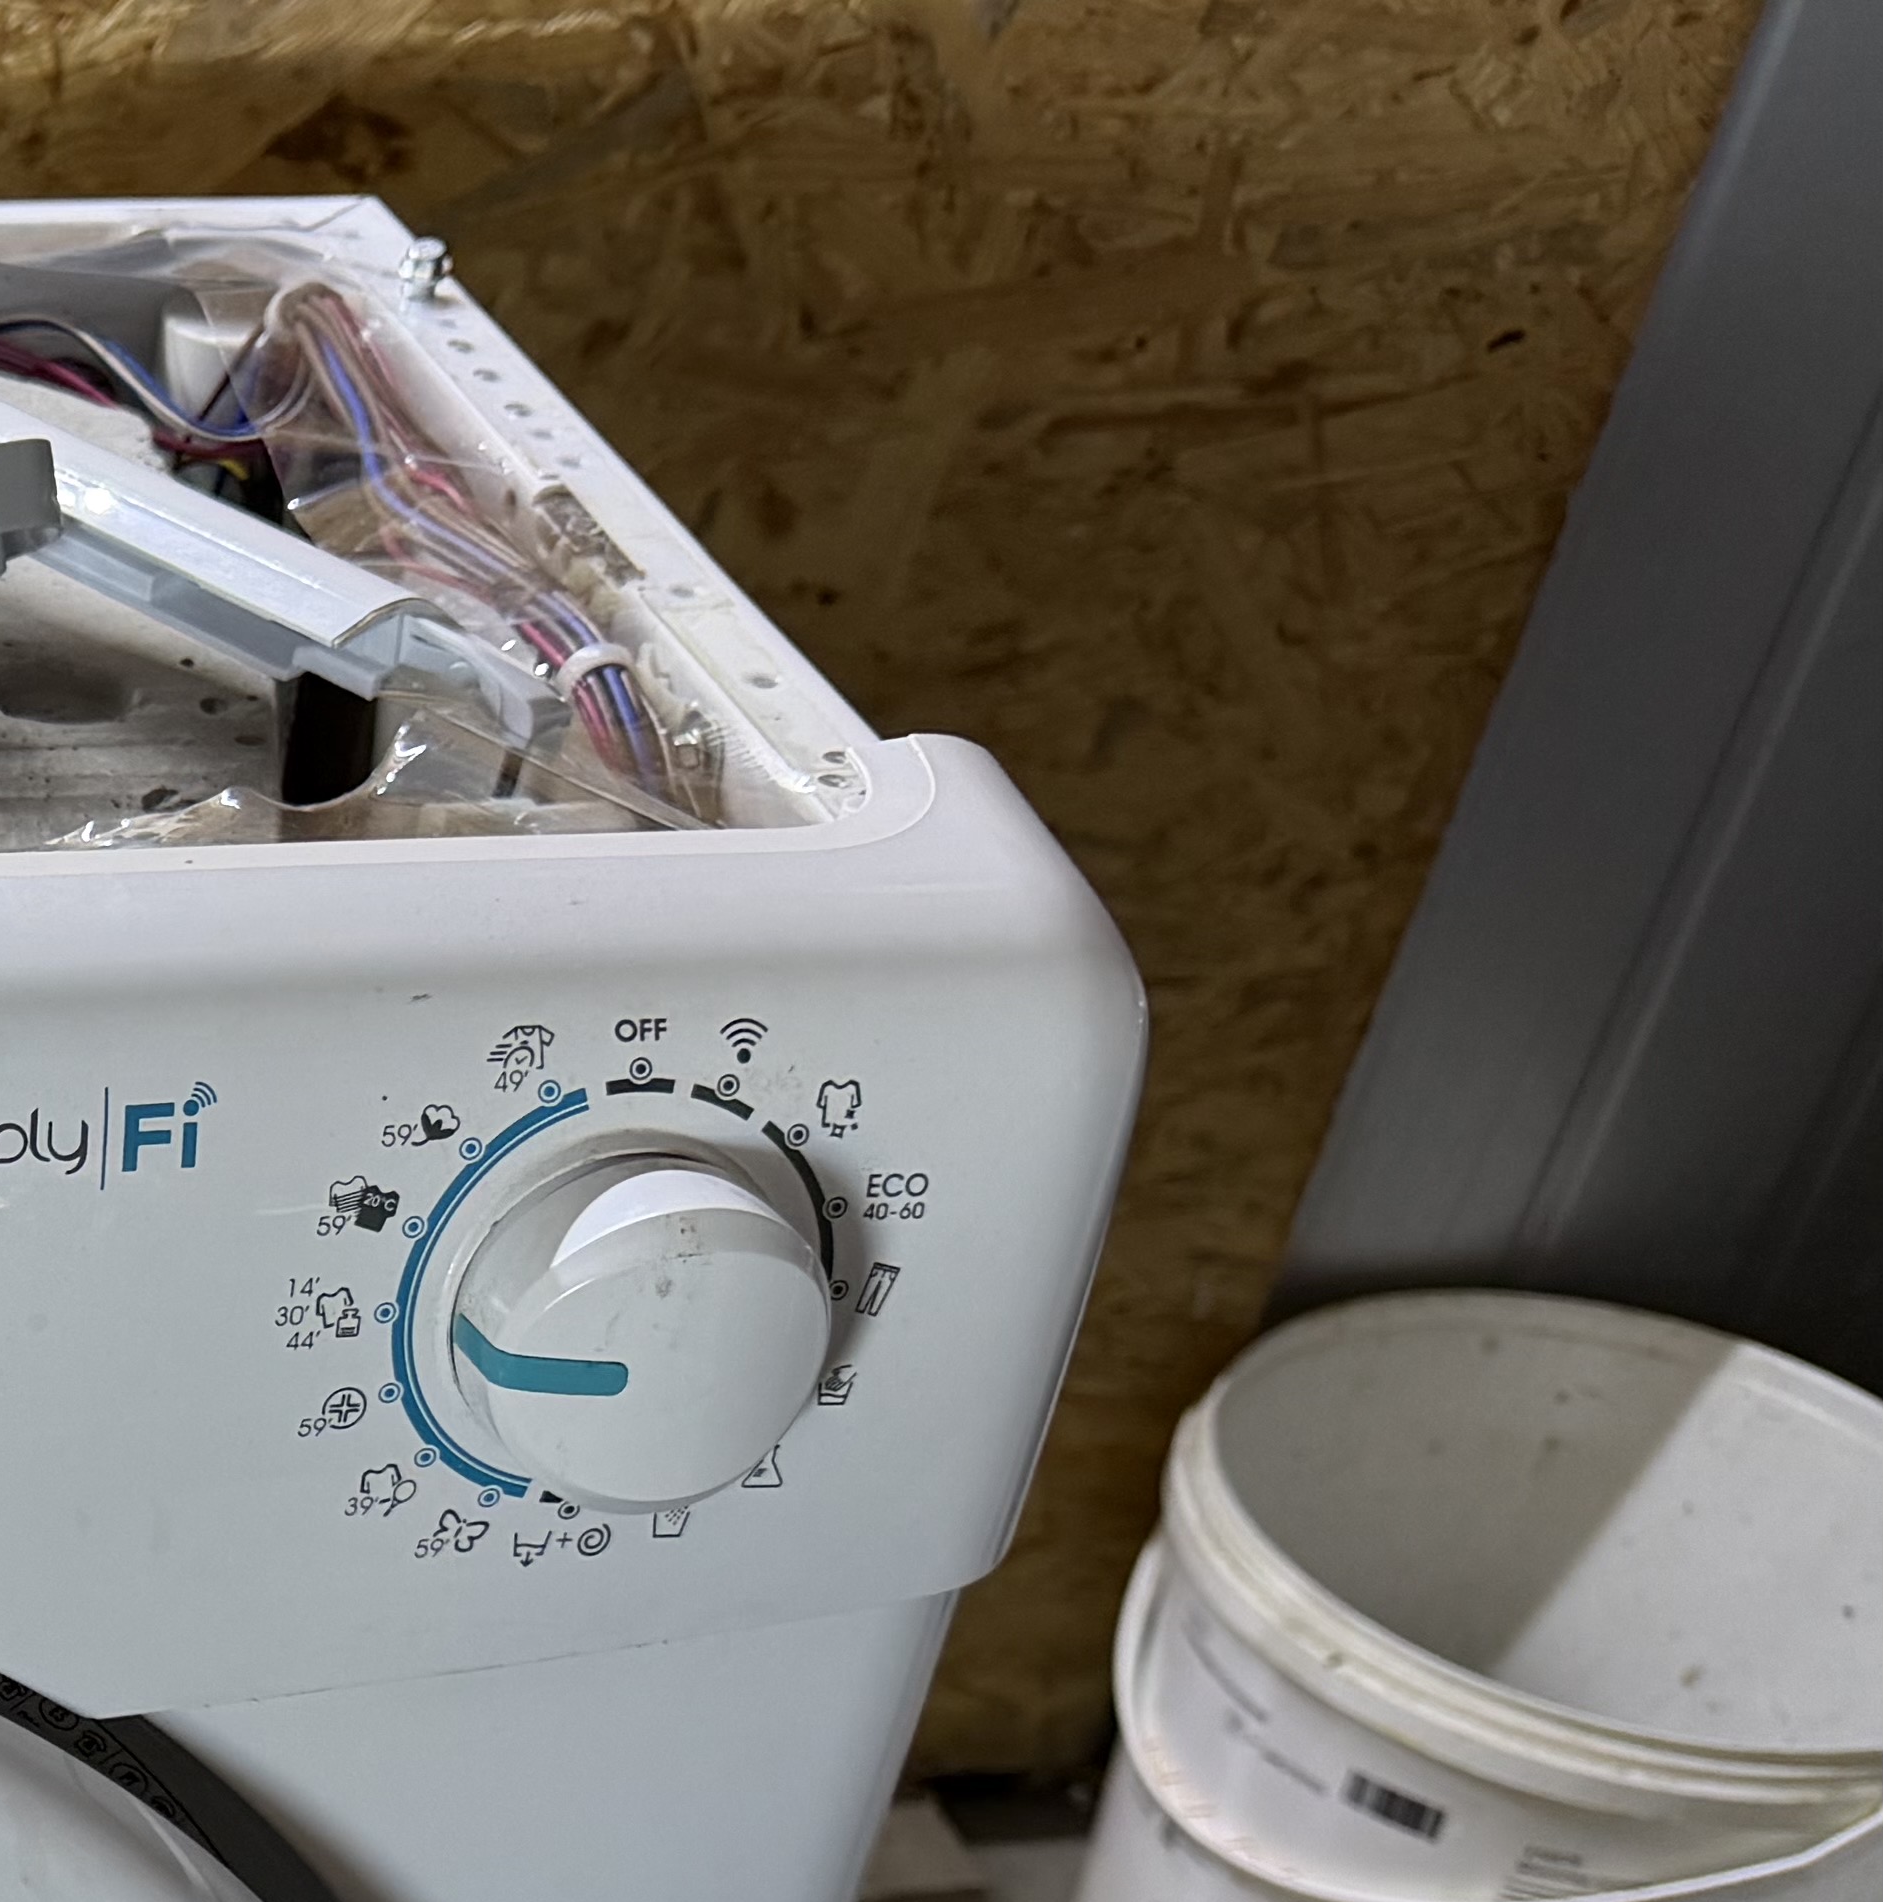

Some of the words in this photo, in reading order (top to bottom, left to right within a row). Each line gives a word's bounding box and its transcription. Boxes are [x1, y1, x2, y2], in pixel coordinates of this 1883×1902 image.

[614, 1018, 668, 1042] OFF
[121, 1098, 200, 1173] Fi
[381, 1123, 419, 1148] 59'
[866, 1172, 929, 1199] ECO
[862, 1202, 925, 1220] 40-60
[274, 1304, 310, 1327] 30'
[285, 1331, 321, 1350] 44'
